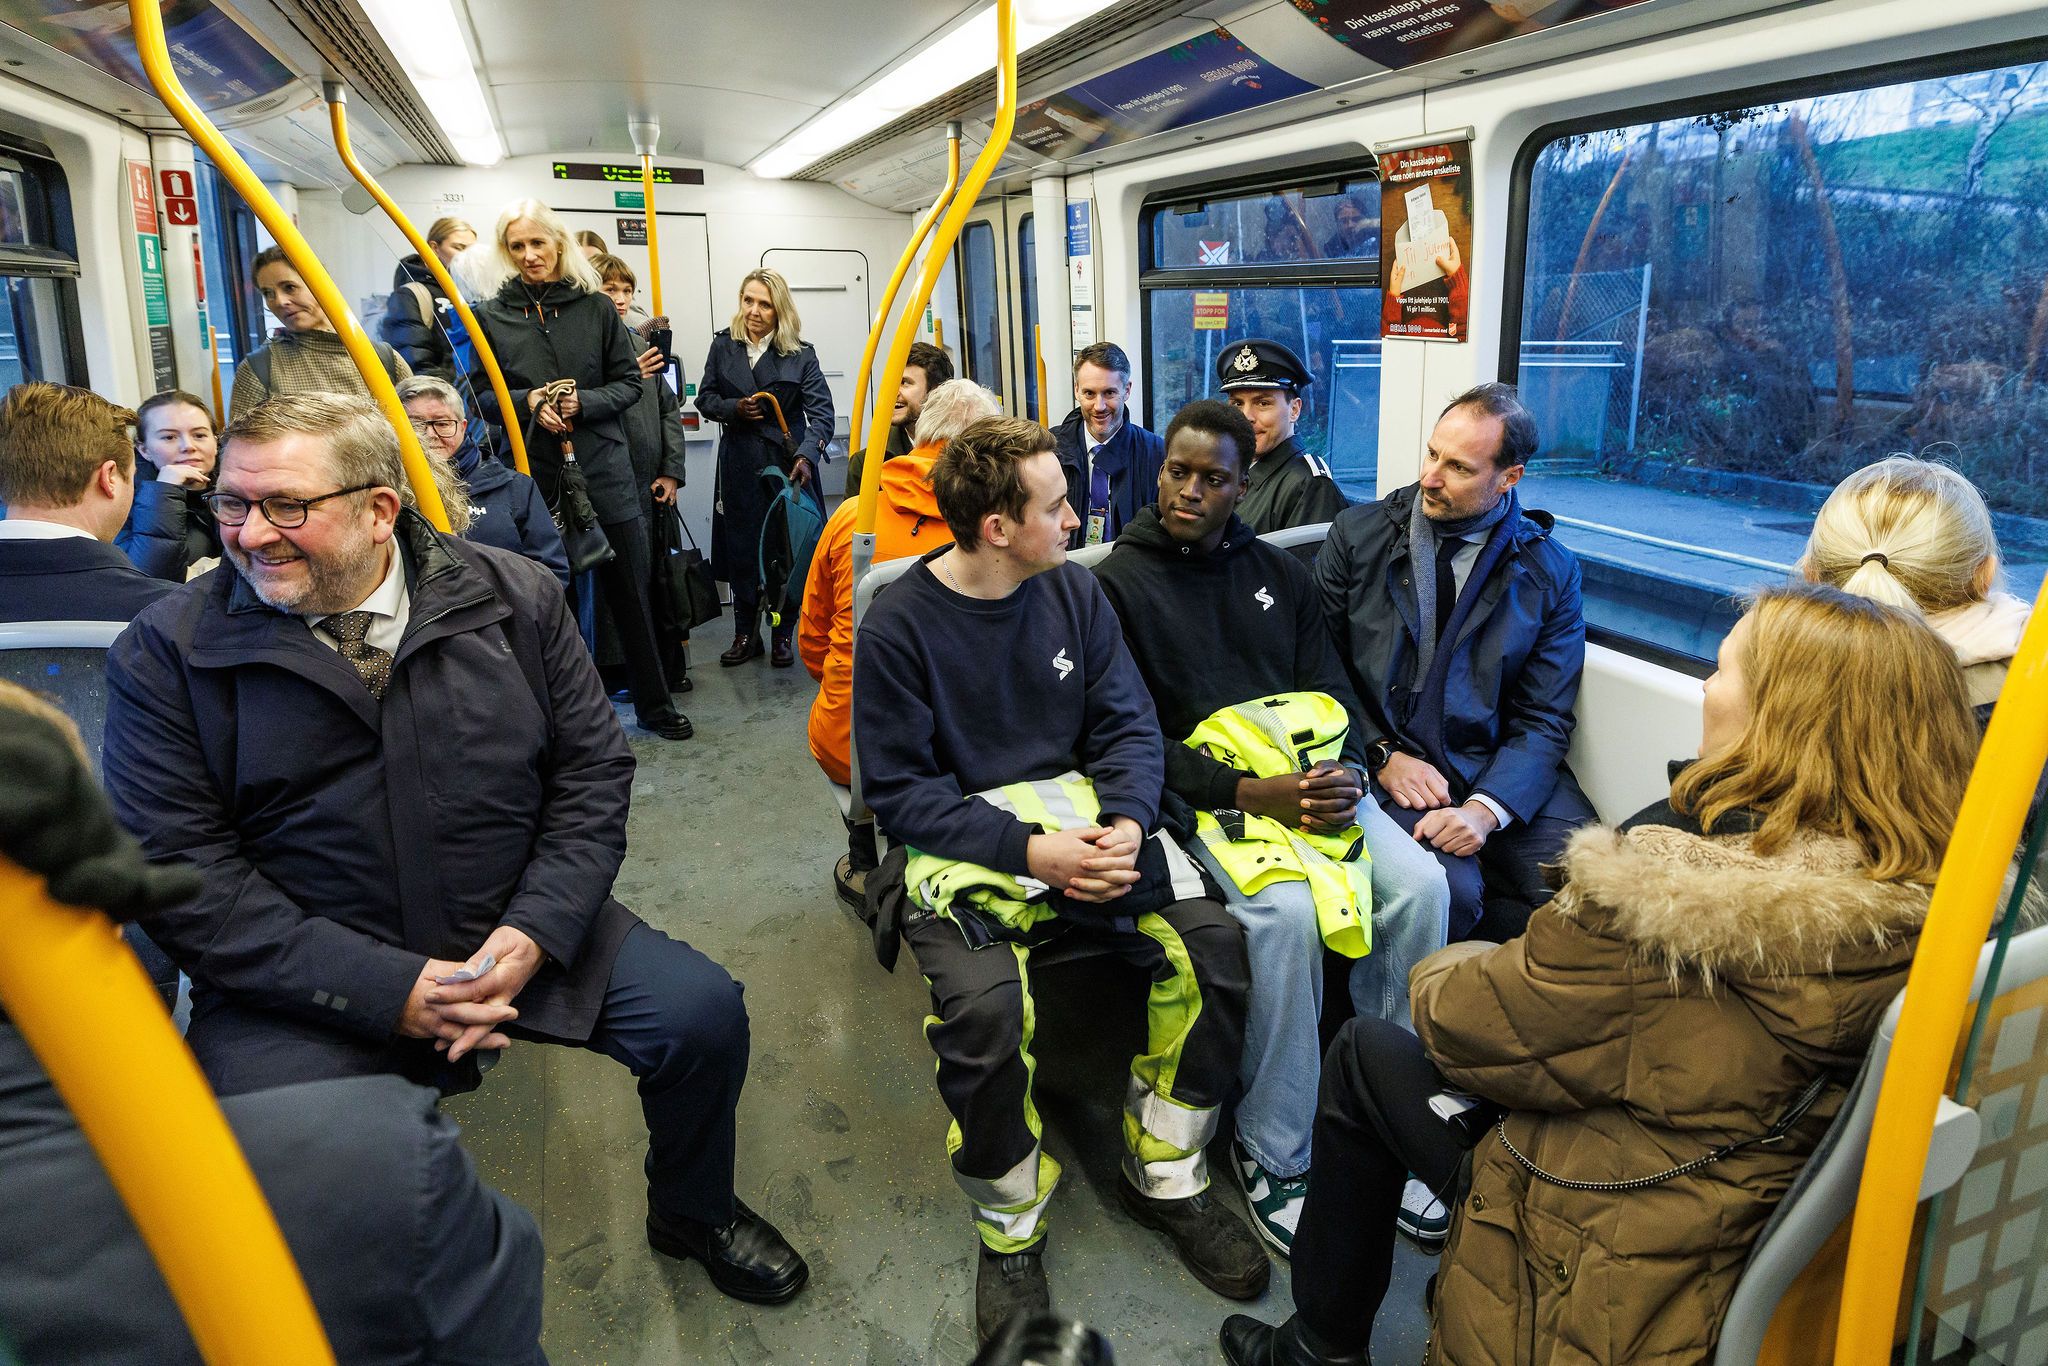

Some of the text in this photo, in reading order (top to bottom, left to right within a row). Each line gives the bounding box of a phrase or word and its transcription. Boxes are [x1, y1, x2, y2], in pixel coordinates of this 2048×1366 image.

[1344, 0, 1422, 30] Din kassalapp
[1362, 4, 1460, 40] være noen andres
[1396, 21, 1454, 42] ønskeliste
[1400, 155, 1446, 168] Din kassalapp kan
[1403, 172, 1415, 180] noen
[1416, 168, 1433, 178] andres
[1434, 164, 1460, 175] ønskeliste
[443, 193, 464, 203] 3331
[908, 910, 929, 921] HELL
